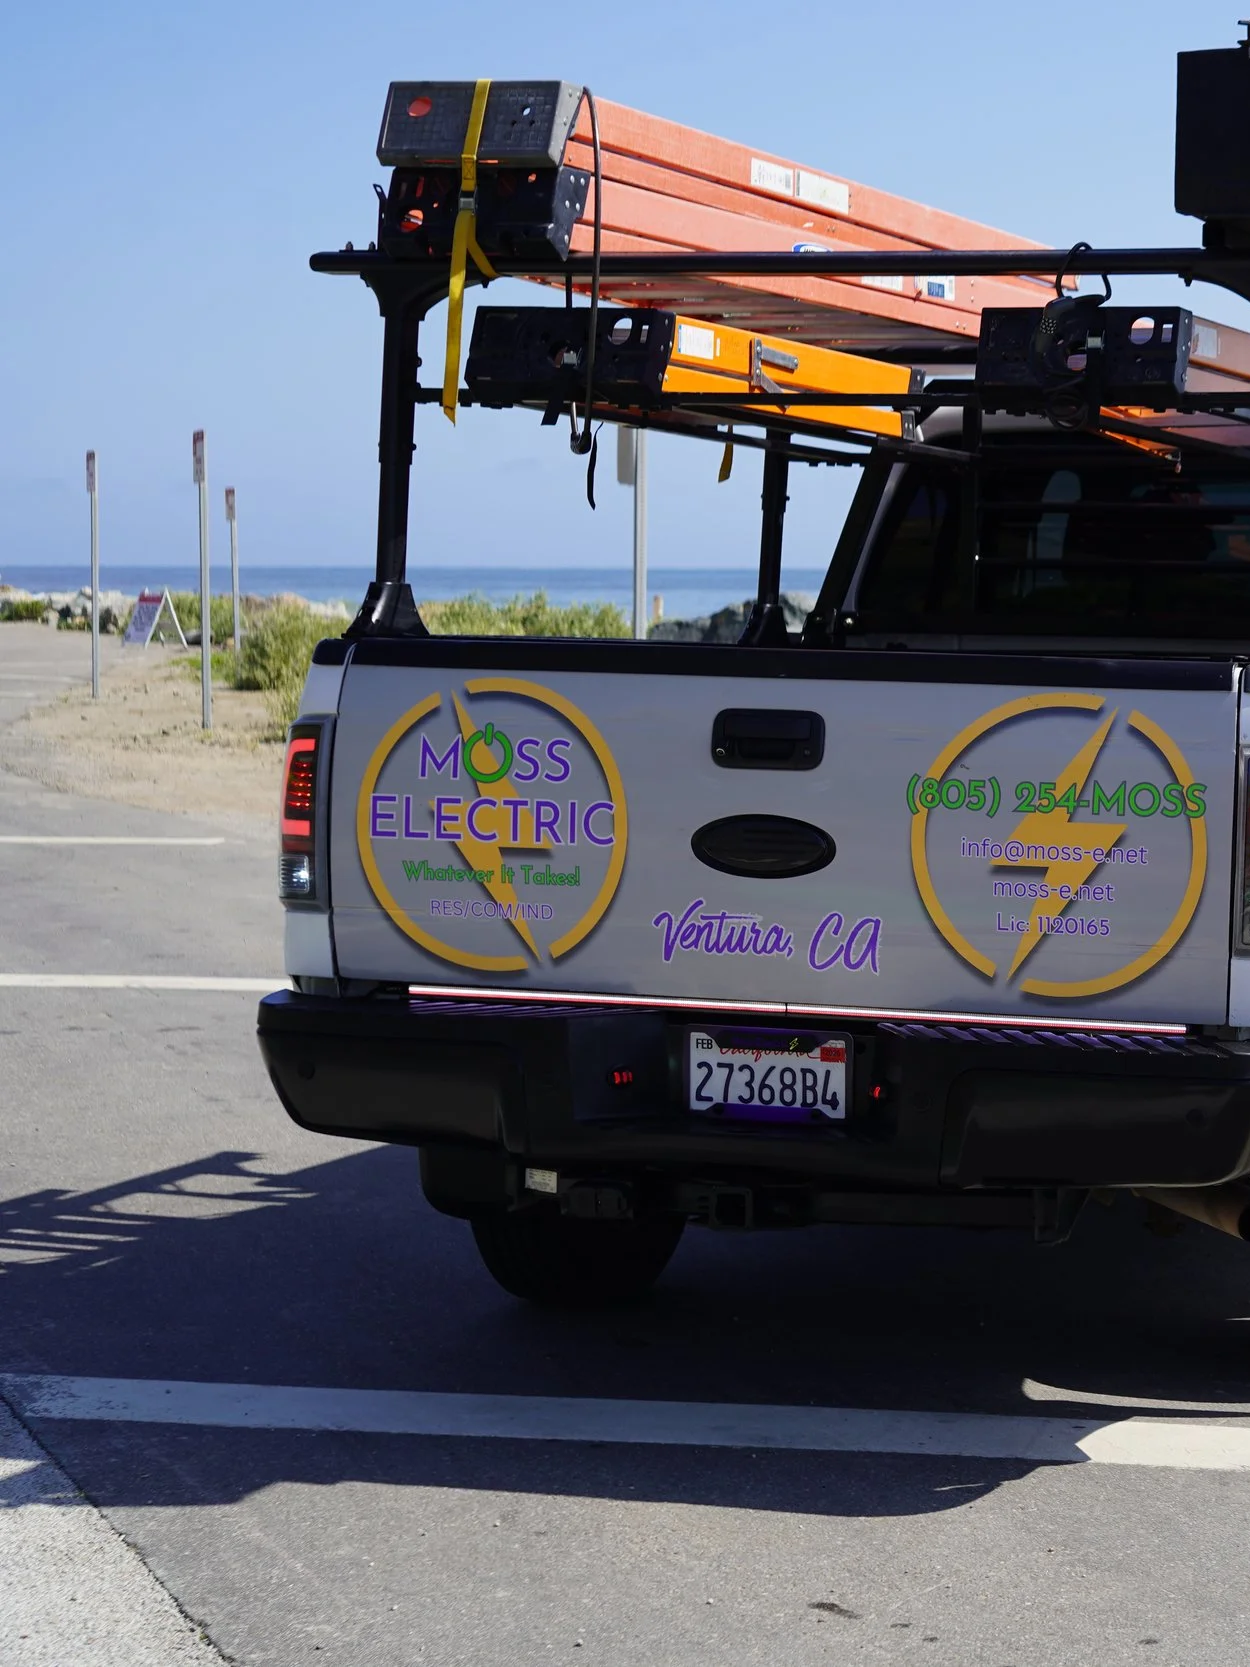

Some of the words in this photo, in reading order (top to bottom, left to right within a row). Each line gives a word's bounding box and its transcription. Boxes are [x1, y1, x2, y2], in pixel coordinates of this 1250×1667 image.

[419, 723, 572, 783] MOSS
[906, 773, 1001, 818] (805)
[1012, 780, 1208, 818] 254-MOSS
[370, 794, 616, 846] ELECTRIC
[960, 836, 1148, 865] info@moss-e.net
[402, 861, 494, 884] Whatever
[501, 864, 515, 884] It
[521, 865, 581, 887] Takes!
[992, 879, 1115, 902] moss-e.net
[430, 900, 553, 920] RES/COM/IND
[996, 912, 1030, 933] Lic:
[1037, 915, 1110, 937] 1120165
[652, 898, 793, 963] Ventura,
[808, 911, 882, 975] CA
[695, 1037, 713, 1050] FEB
[695, 1061, 840, 1111] 27368B4
